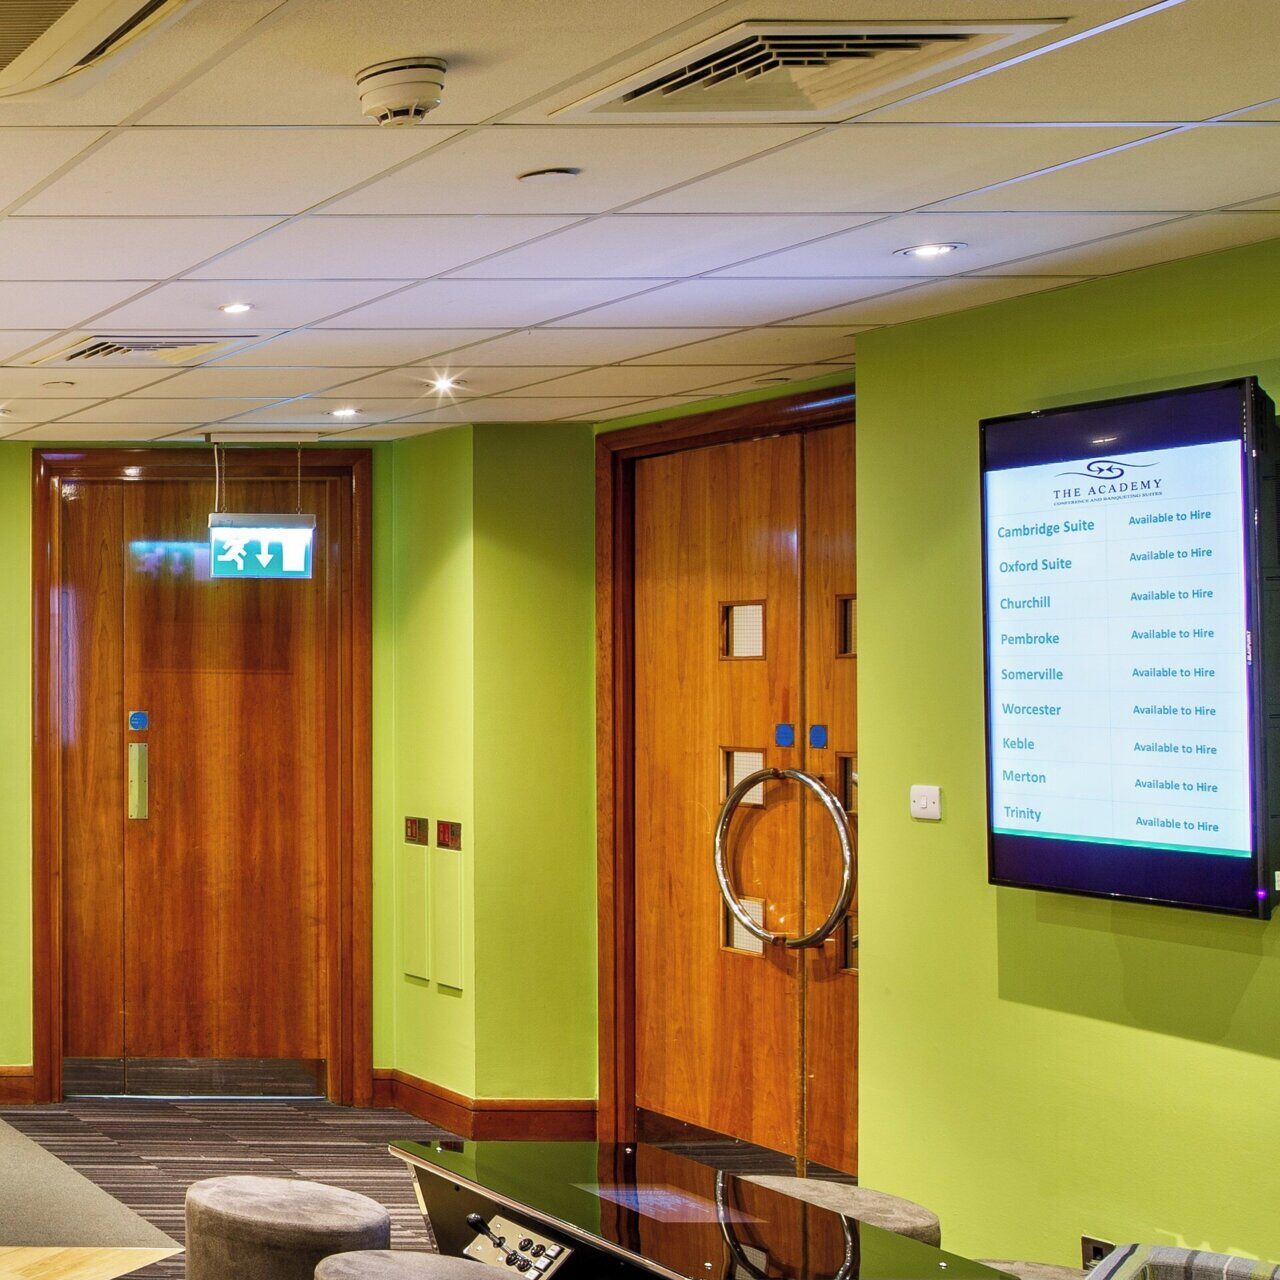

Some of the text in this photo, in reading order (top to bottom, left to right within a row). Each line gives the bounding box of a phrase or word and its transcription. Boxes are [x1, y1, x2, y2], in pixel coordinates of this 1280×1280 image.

[1053, 478, 1163, 500] THE ACADEMY
[1128, 510, 1212, 525] Available to Hire
[997, 520, 1095, 538] Cambridge Suite
[1129, 547, 1213, 562] Available to Hire
[999, 557, 1072, 573] Oxford Suite
[1130, 589, 1214, 601] Available to Hire
[1000, 595, 1051, 610] Churchill
[1001, 632, 1060, 645] Pembroke
[1131, 628, 1215, 640] Available to Hire
[1001, 667, 1064, 681] Somerville
[1131, 667, 1216, 678] Available to Hire
[1001, 703, 1062, 716] Worcester
[1132, 705, 1217, 716] Available to Hire
[1002, 737, 1035, 750] Keble
[1133, 742, 1218, 755] Available to Hire
[1002, 770, 1046, 784] Merton
[1134, 778, 1218, 793] Available to Hire
[1003, 806, 1042, 823] Trinity
[1135, 816, 1219, 833] Available to Hire
